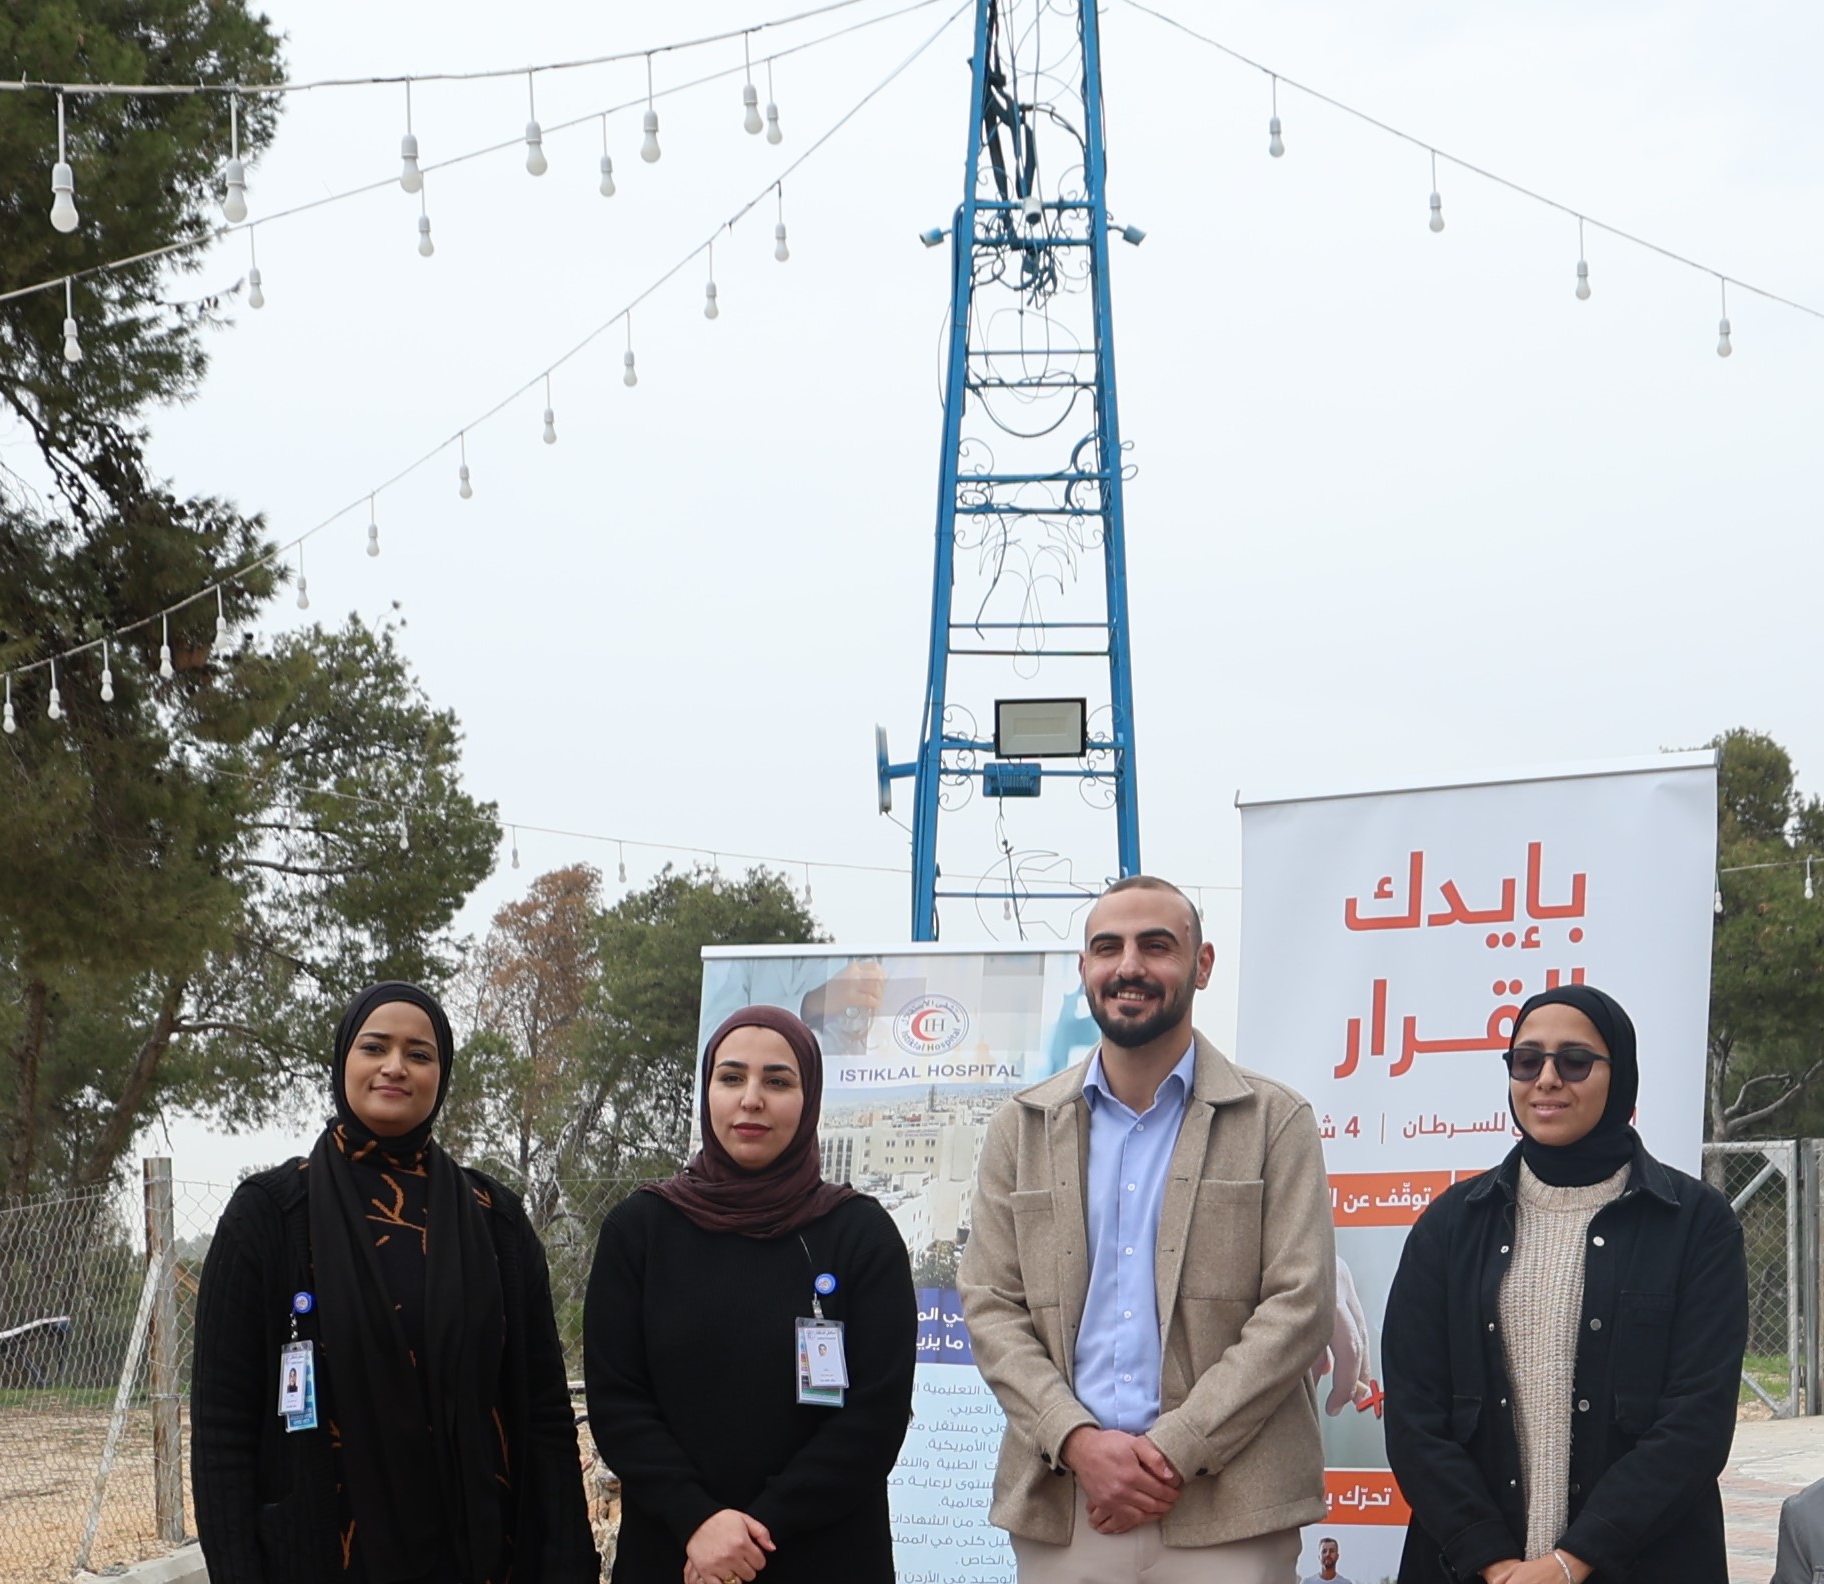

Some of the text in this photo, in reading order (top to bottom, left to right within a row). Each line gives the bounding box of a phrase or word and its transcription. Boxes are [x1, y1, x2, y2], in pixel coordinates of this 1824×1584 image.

[1345, 841, 1587, 950] بإيدك
[924, 1018, 945, 1032] IH
[927, 1028, 961, 1052] Hospital
[839, 1064, 1022, 1082] ISTIKLAL HOSPITAL
[1344, 1115, 1360, 1138] 4
[1403, 1111, 1507, 1139] للسرطان
[1343, 1194, 1370, 1214] عن
[916, 1333, 940, 1351] يزي
[923, 1383, 980, 1396] التعليمية
[929, 1421, 977, 1433] مستقل
[937, 1458, 977, 1470] الطبية
[953, 1517, 973, 1528] من
[930, 1536, 952, 1549] في
[904, 1571, 939, 1584] الأردن
